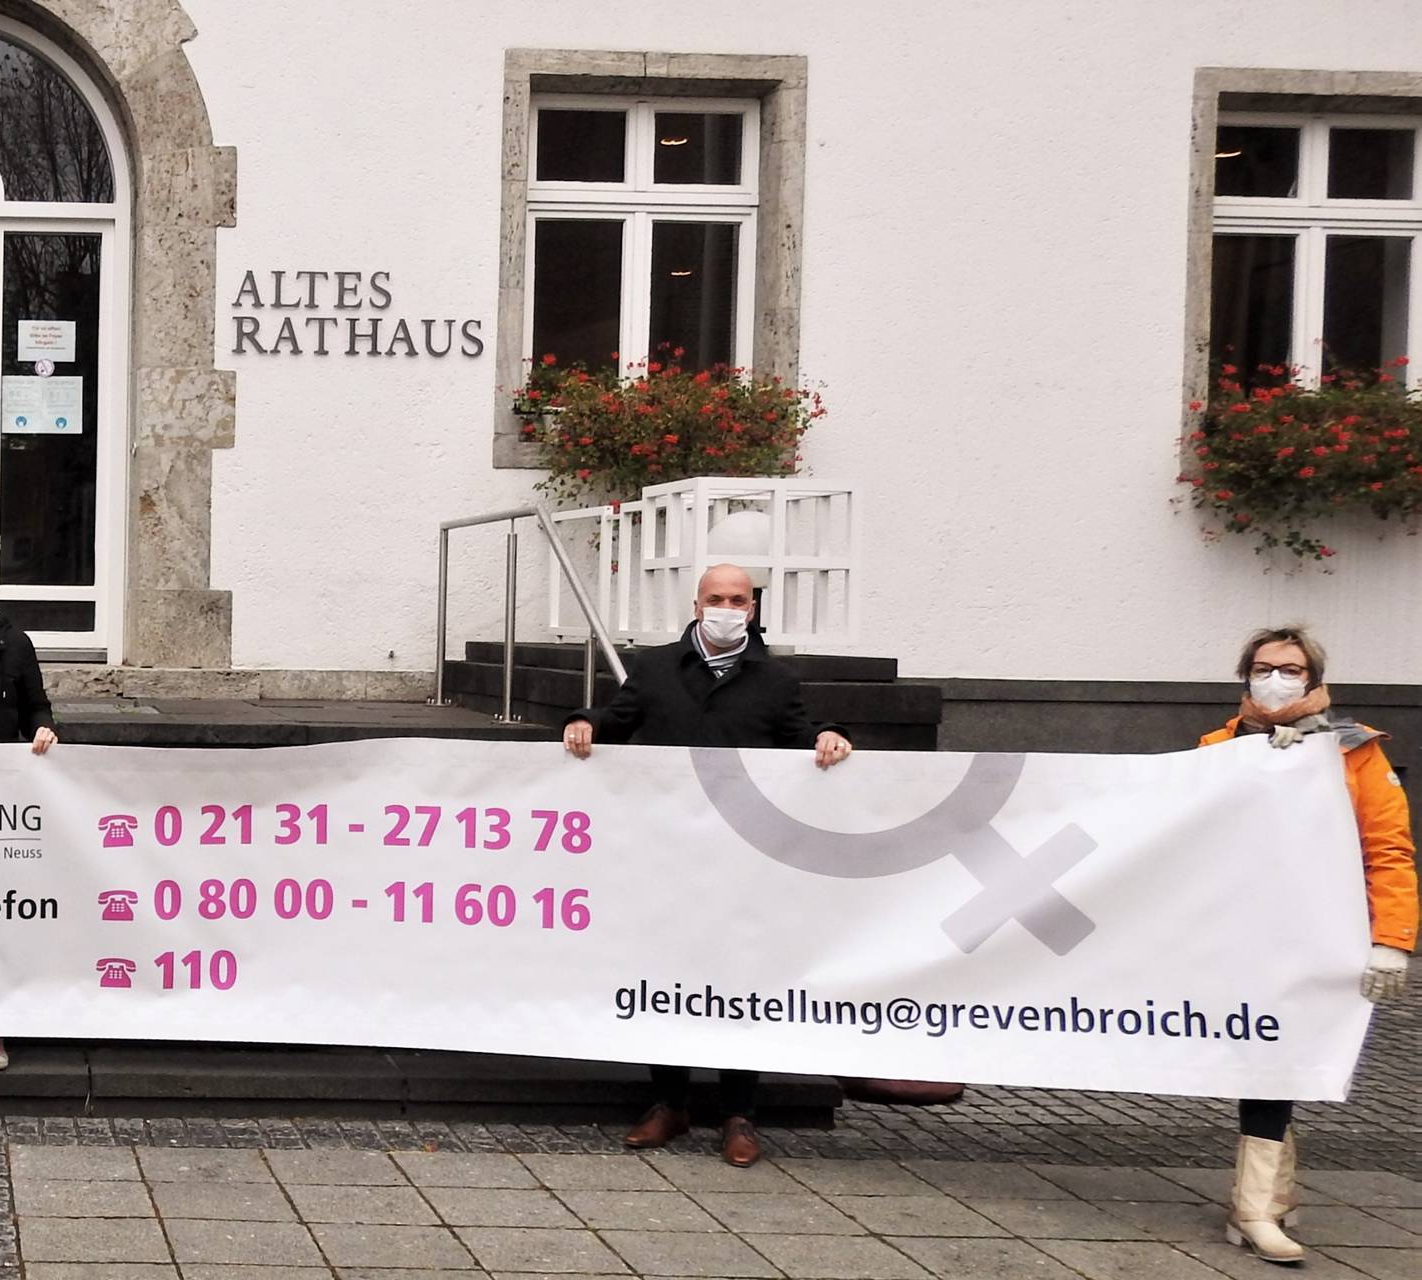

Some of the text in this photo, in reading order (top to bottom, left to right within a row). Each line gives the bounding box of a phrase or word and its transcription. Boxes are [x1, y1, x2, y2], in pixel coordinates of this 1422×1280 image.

[232, 270, 391, 309] ALTES
[232, 317, 483, 358] RATHAUS
[155, 805, 182, 846] 0
[200, 805, 252, 844] 21
[275, 804, 327, 844] 31
[384, 805, 441, 846] 27
[456, 807, 511, 850] 13
[531, 810, 591, 854] 78
[4, 847, 42, 858] Neuss
[154, 880, 181, 920] 0
[198, 879, 257, 919] 80
[274, 879, 333, 920] 00
[385, 882, 433, 923] 11
[455, 884, 516, 927] 60
[533, 888, 590, 931] 16
[154, 950, 237, 990] 110
[616, 980, 1279, 1041] gleichstellung@grevenbroich.de
